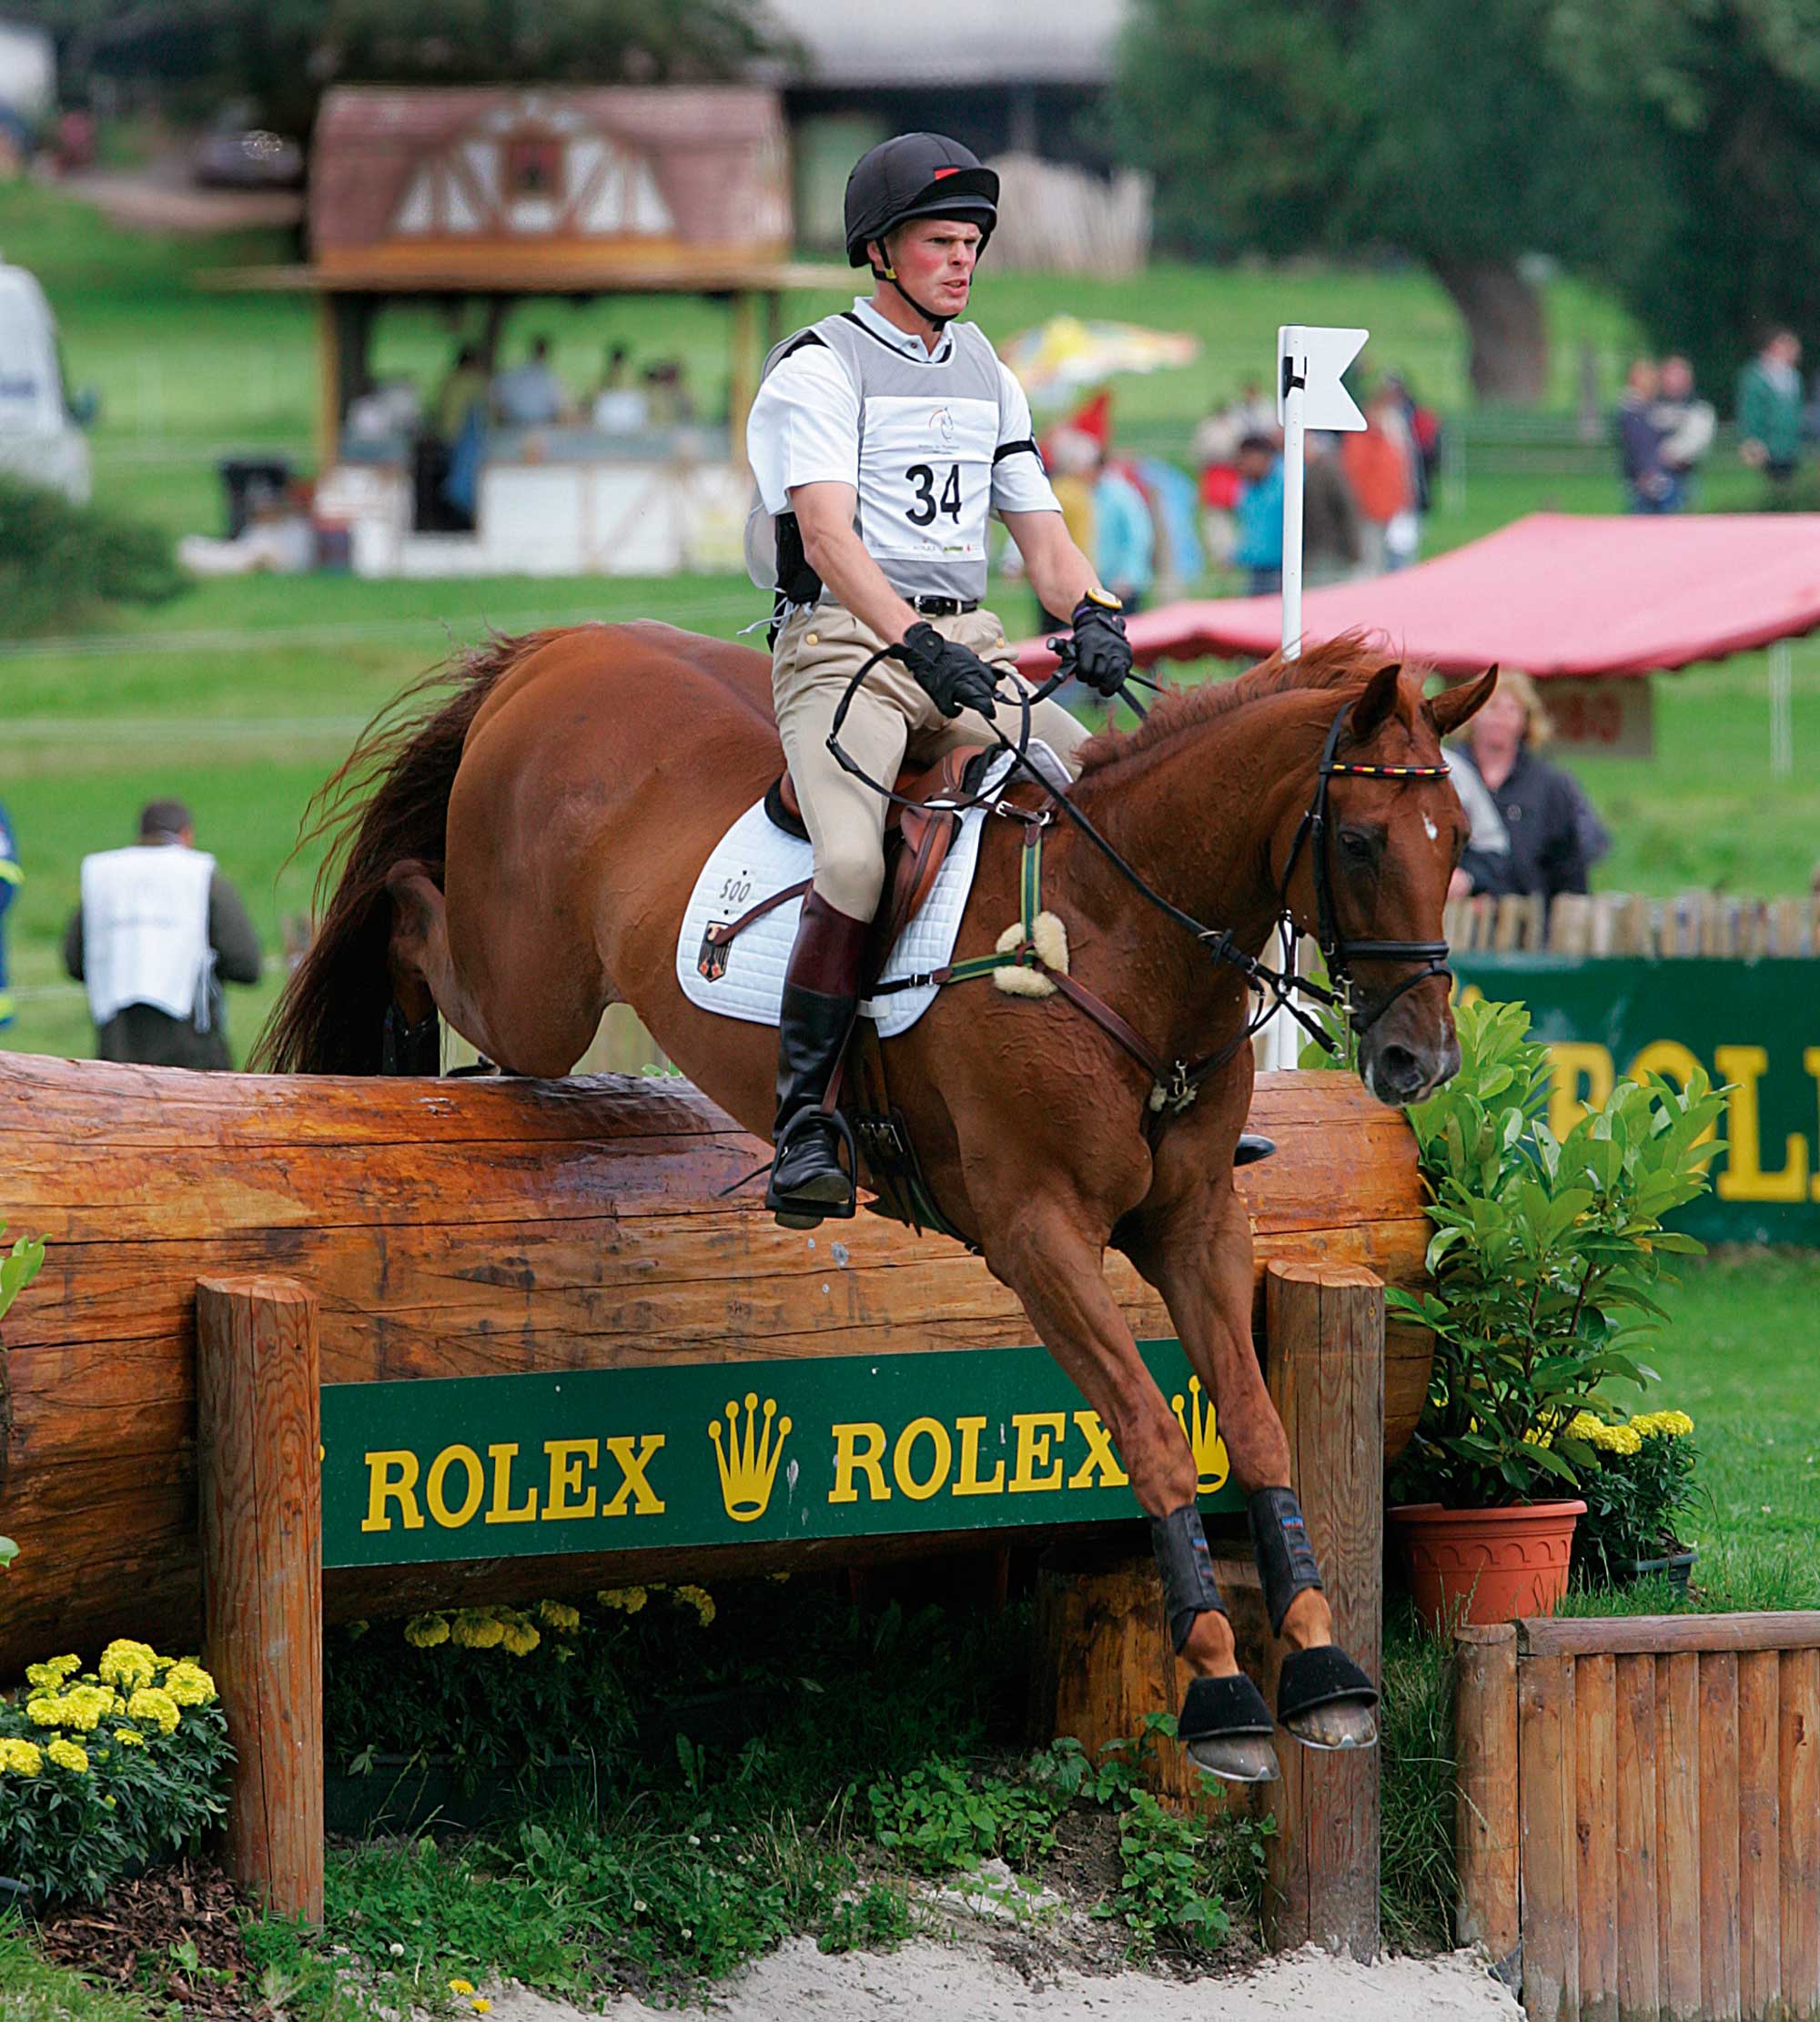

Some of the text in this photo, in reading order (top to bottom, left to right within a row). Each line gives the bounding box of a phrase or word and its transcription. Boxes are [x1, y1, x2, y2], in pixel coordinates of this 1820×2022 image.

[905, 463, 962, 527] 34
[720, 878, 751, 903] 500
[361, 1410, 1129, 1532] ROLEX ROLEX
